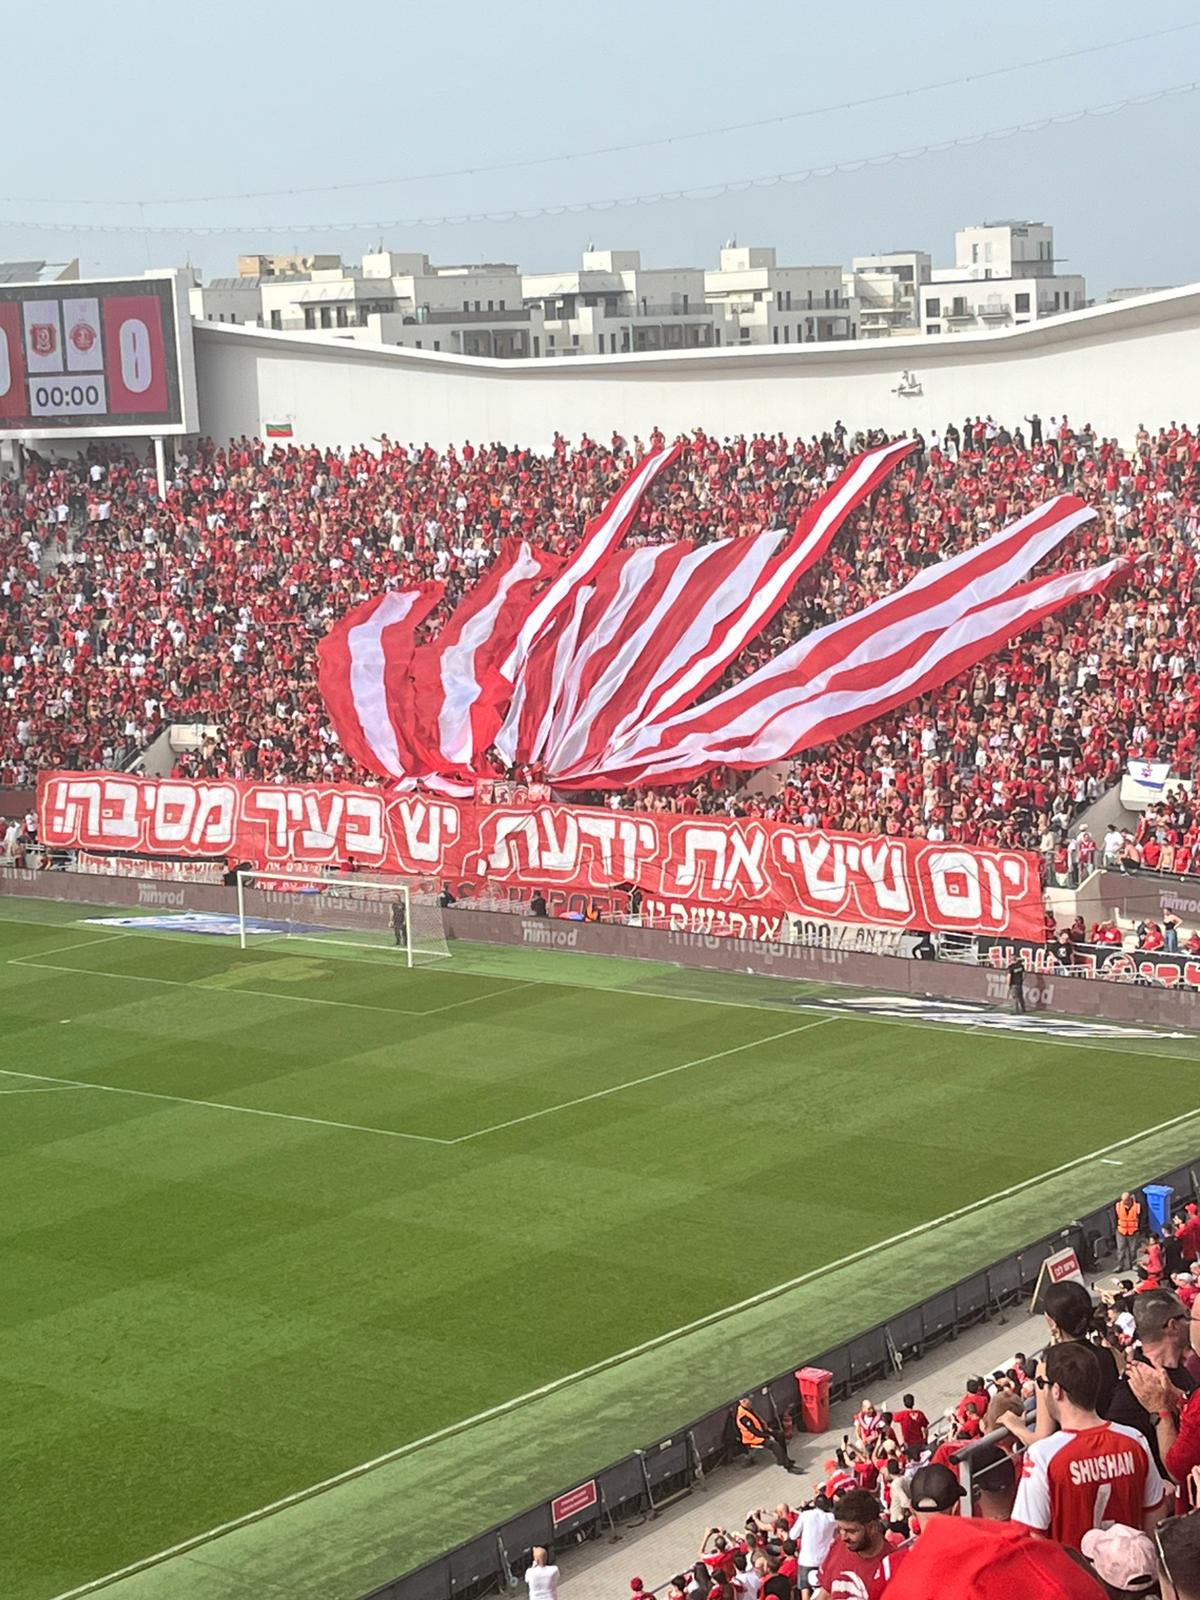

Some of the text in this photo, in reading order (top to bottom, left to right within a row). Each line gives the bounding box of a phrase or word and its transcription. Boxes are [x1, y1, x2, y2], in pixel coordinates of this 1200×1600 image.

[36, 386, 99, 407] 00:00
[53, 782, 236, 845] מסיבה!
[256, 792, 384, 855] בעיר
[400, 800, 457, 862] יש
[675, 828, 765, 892] את
[782, 836, 910, 913] שישי
[929, 852, 1020, 920] יום
[138, 890, 185, 905] nimrod
[523, 927, 577, 946] nimrod
[1069, 1451, 1136, 1486] SHUSHAN
